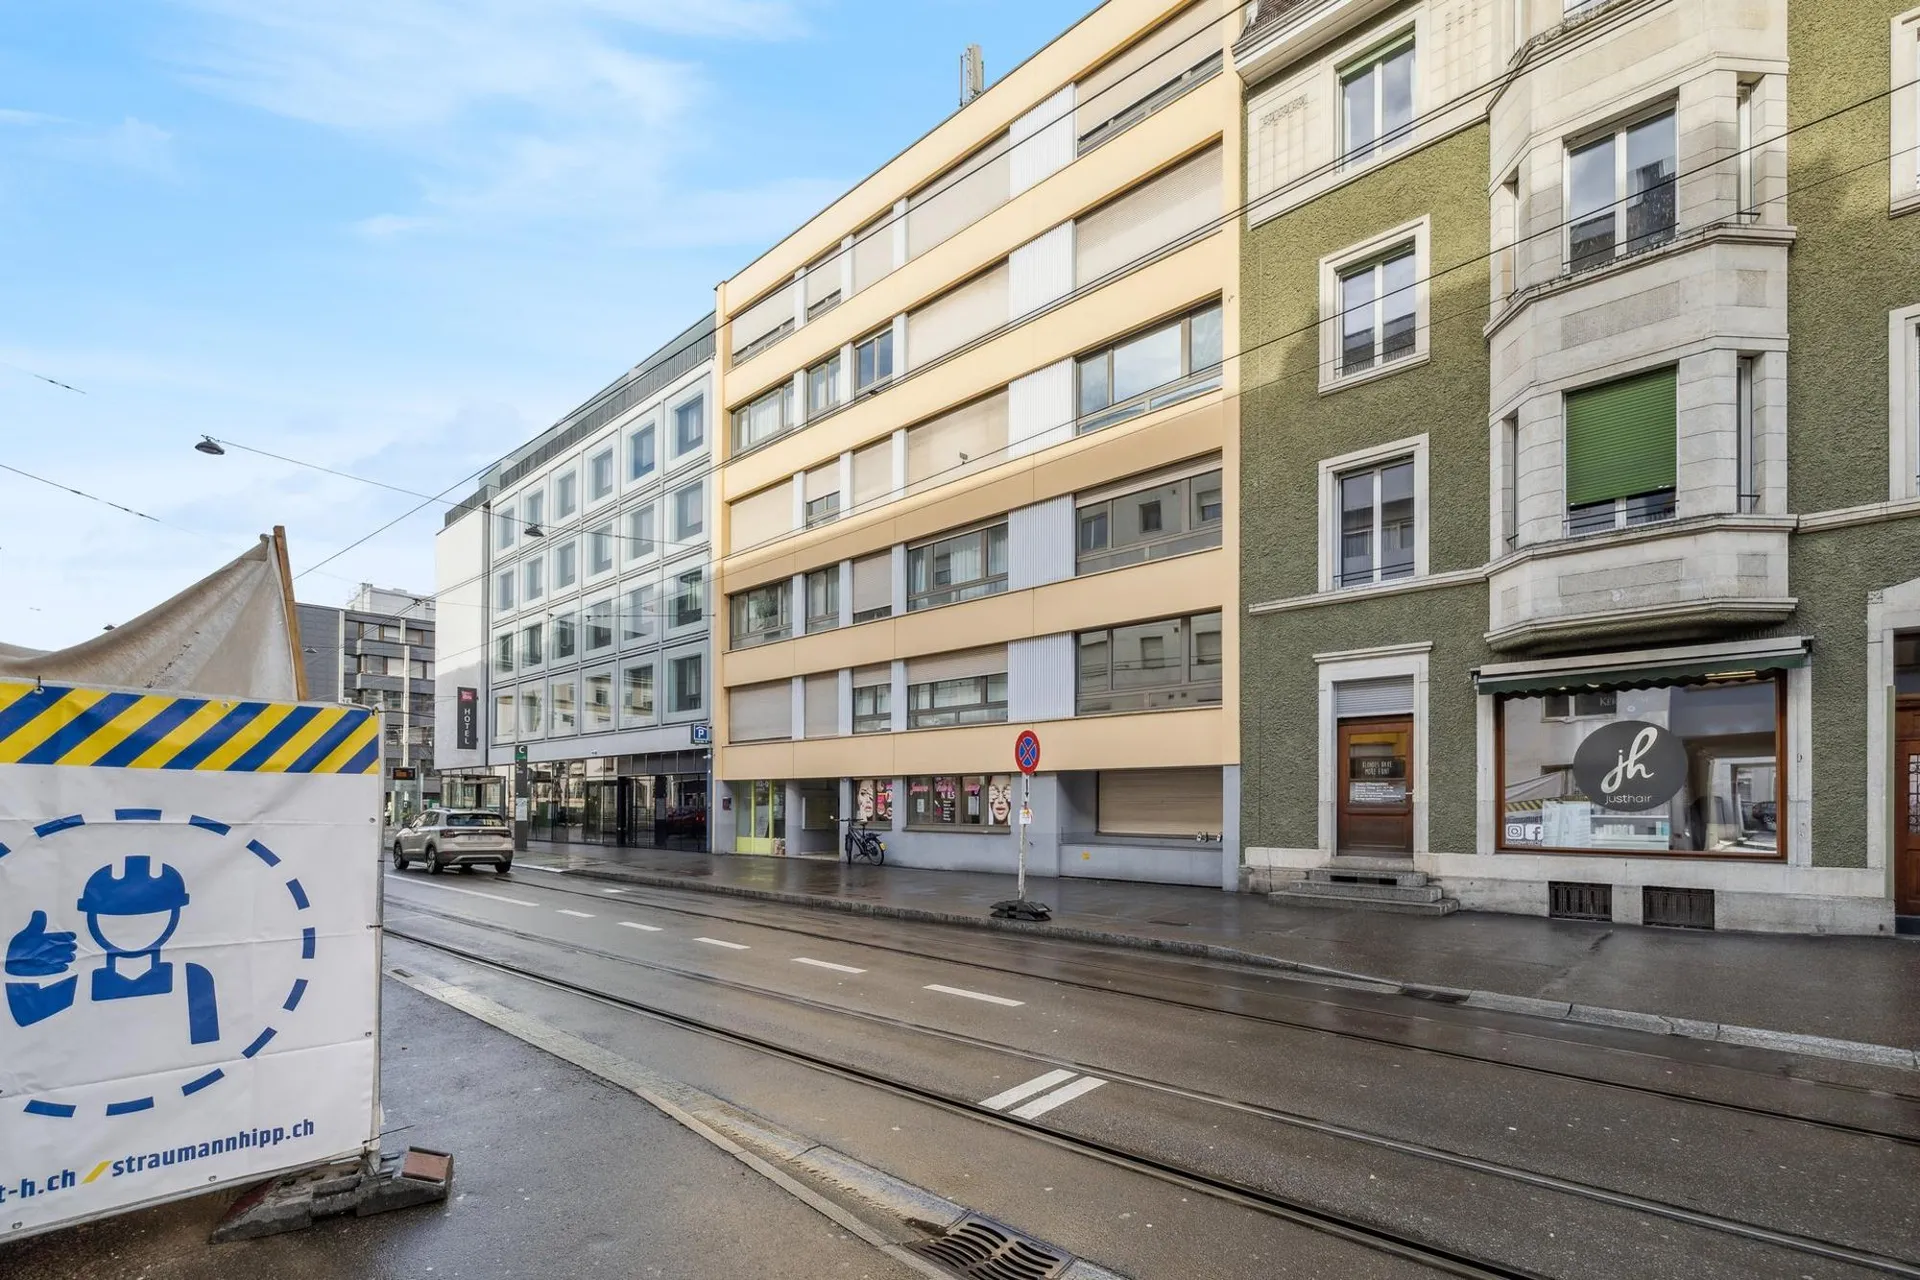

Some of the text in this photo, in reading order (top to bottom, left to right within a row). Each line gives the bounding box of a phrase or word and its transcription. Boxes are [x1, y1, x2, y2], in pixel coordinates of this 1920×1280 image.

[698, 729, 704, 738] P
[1600, 726, 1658, 794] jh
[1604, 794, 1652, 805] justhair
[111, 1119, 314, 1177] straumannhipp.ch
